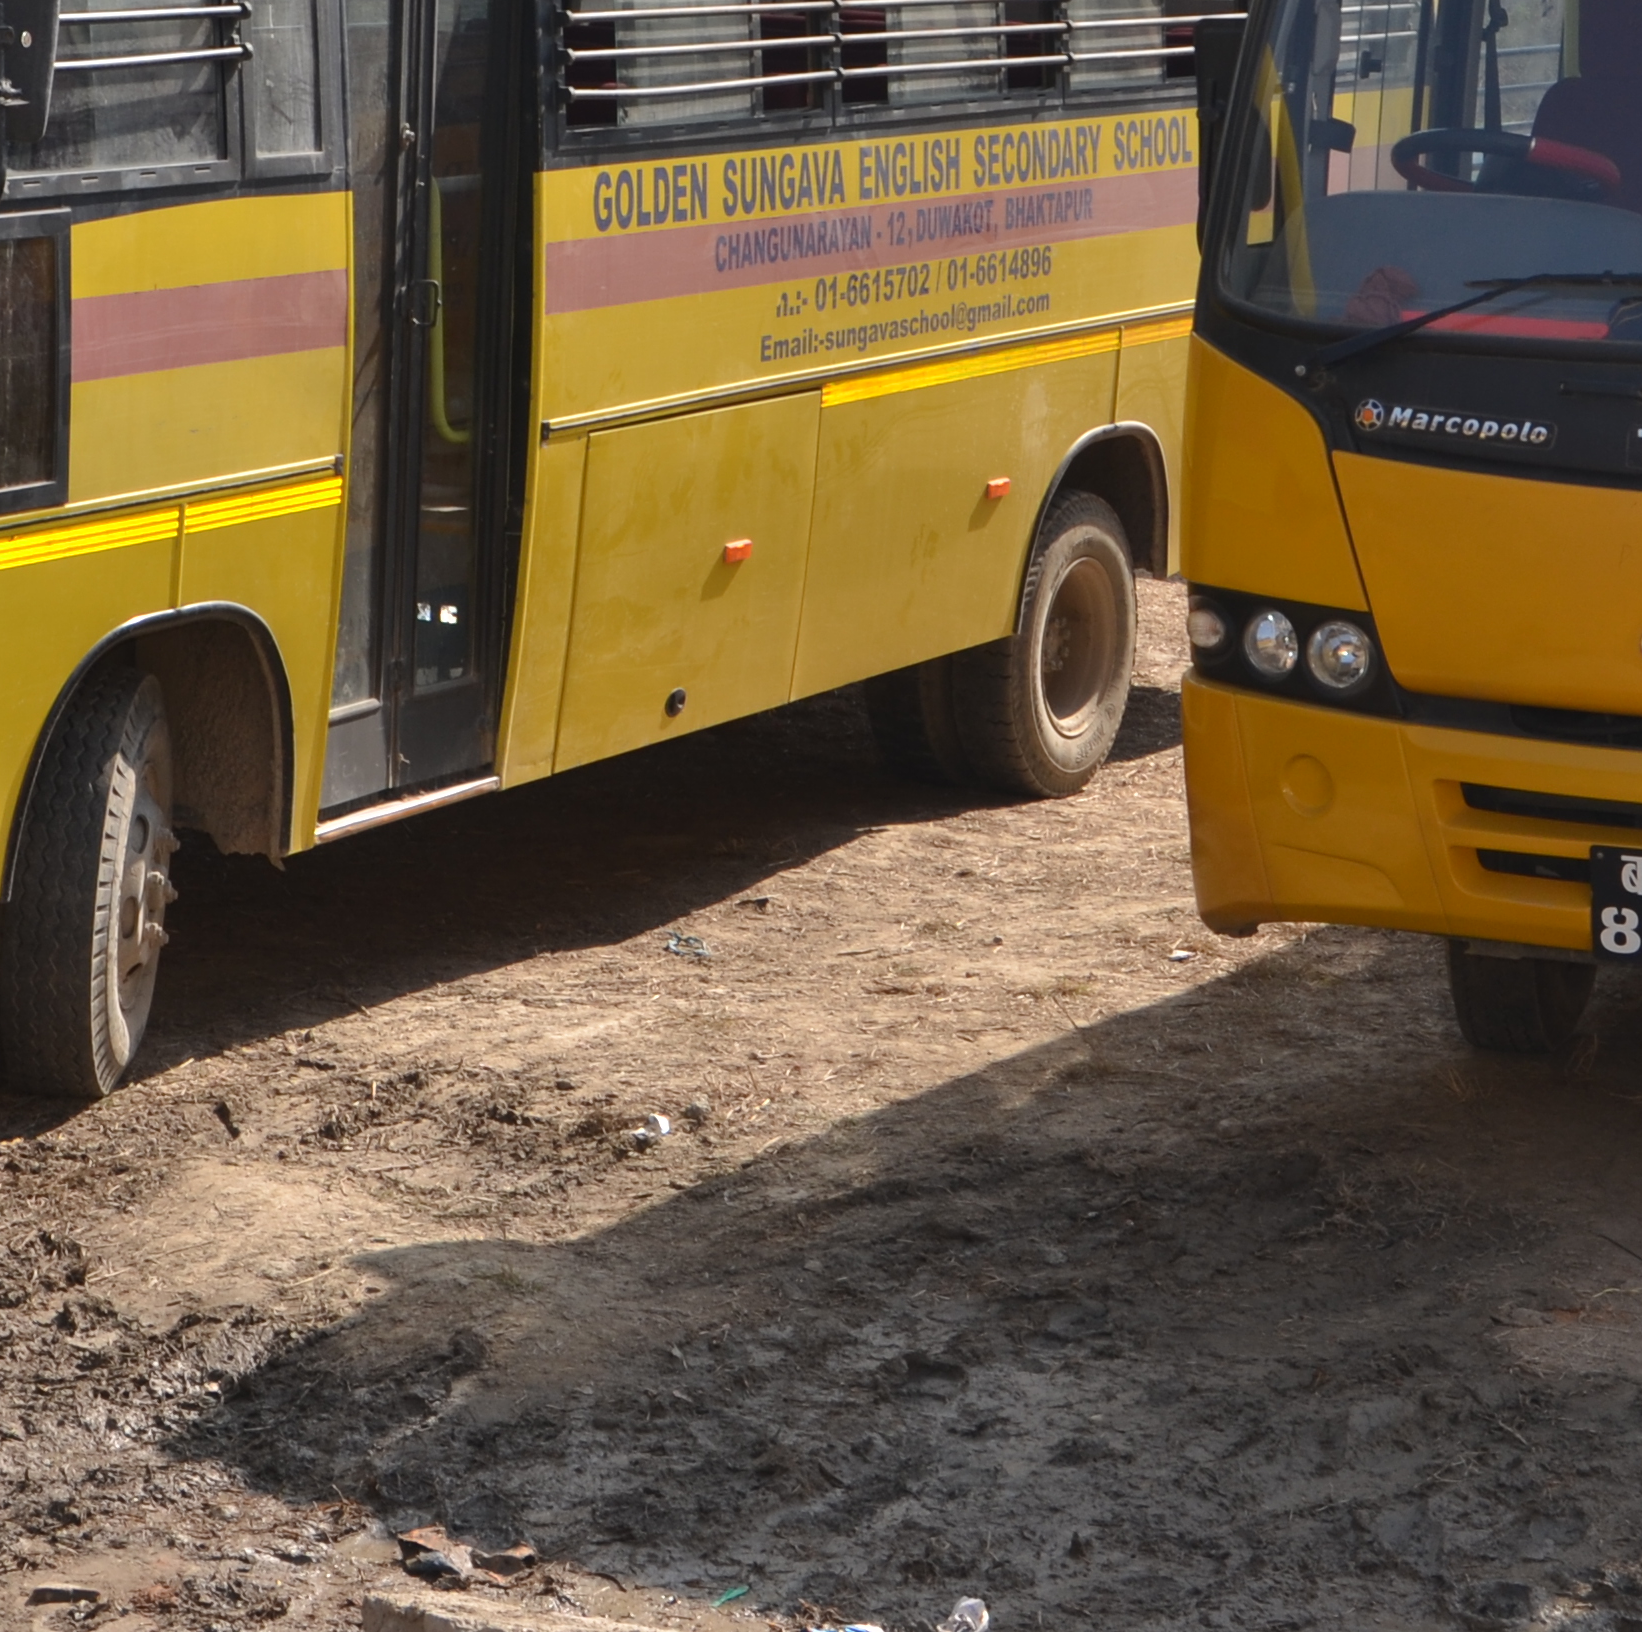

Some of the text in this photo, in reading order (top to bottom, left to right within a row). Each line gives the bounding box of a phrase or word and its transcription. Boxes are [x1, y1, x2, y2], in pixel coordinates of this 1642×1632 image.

[594, 116, 1192, 231] GOLDEN SUNGAVA ENGLISH SECONDARY SCHOOL
[715, 216, 871, 272] CHANGUNARAYAN
[1005, 188, 1092, 230] BHAKTAPUR
[815, 264, 930, 311] 01-6615702
[947, 246, 1051, 290] 01-6614896
[1389, 406, 1548, 444] Marcopolo
